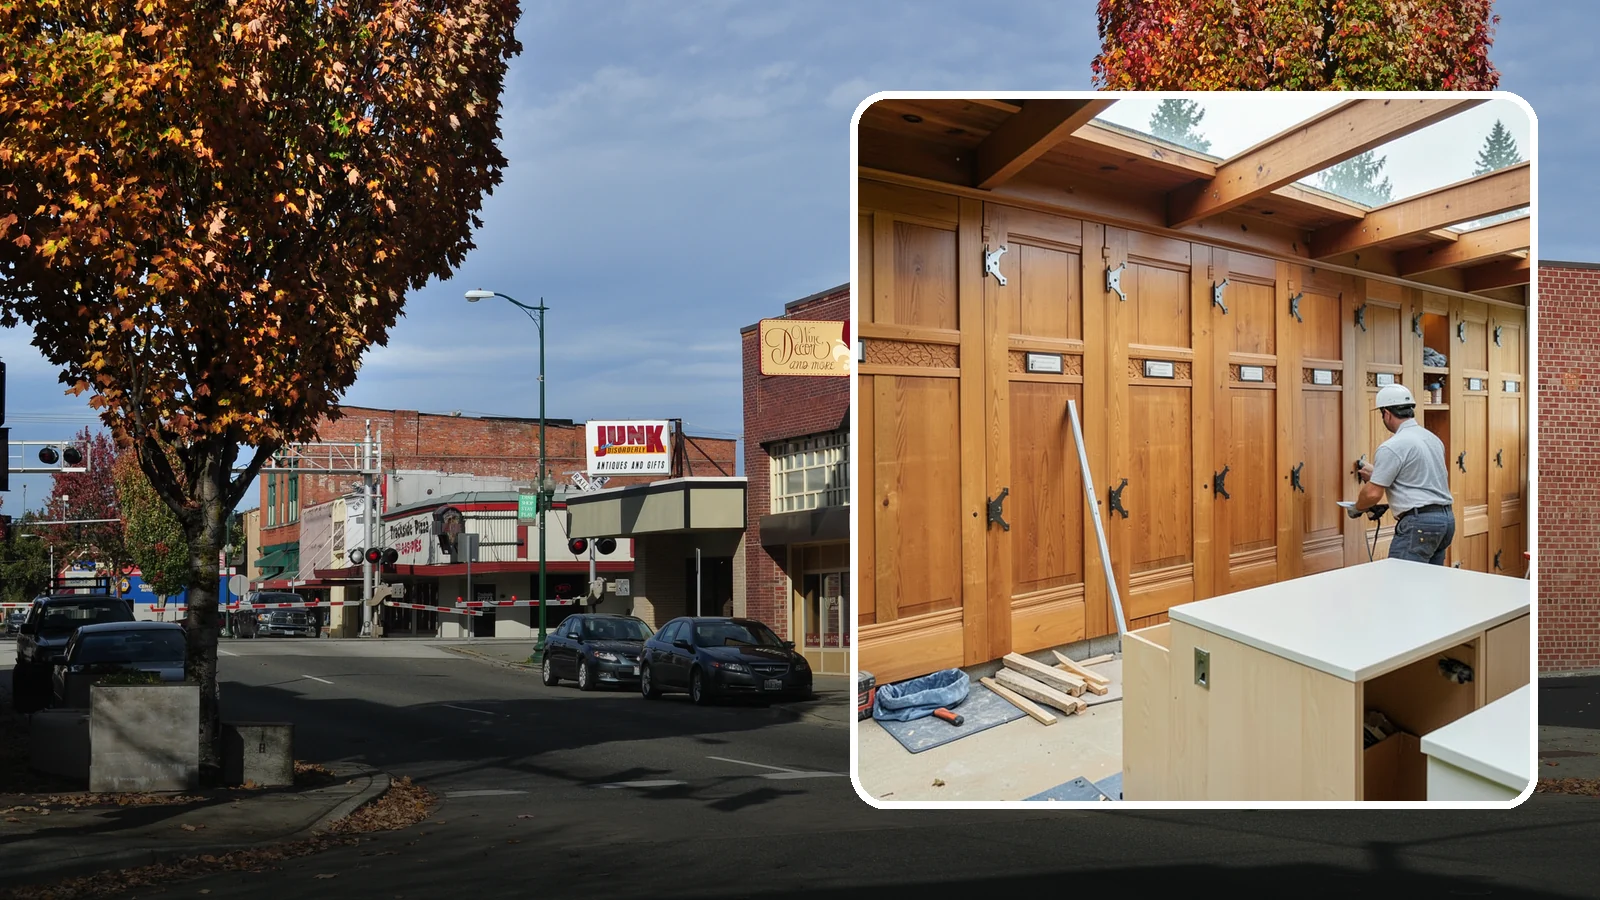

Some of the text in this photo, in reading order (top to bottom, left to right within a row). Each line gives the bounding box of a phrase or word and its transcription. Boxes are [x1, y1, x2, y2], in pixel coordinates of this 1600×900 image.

[765, 328, 831, 365] Decor
[595, 425, 665, 457] JUNK
[607, 446, 646, 454] DISORDERLY
[597, 460, 665, 470] ANTIQUES AND GIFTS
[573, 473, 589, 492] RAIL
[390, 519, 429, 539] Trackside Pizza
